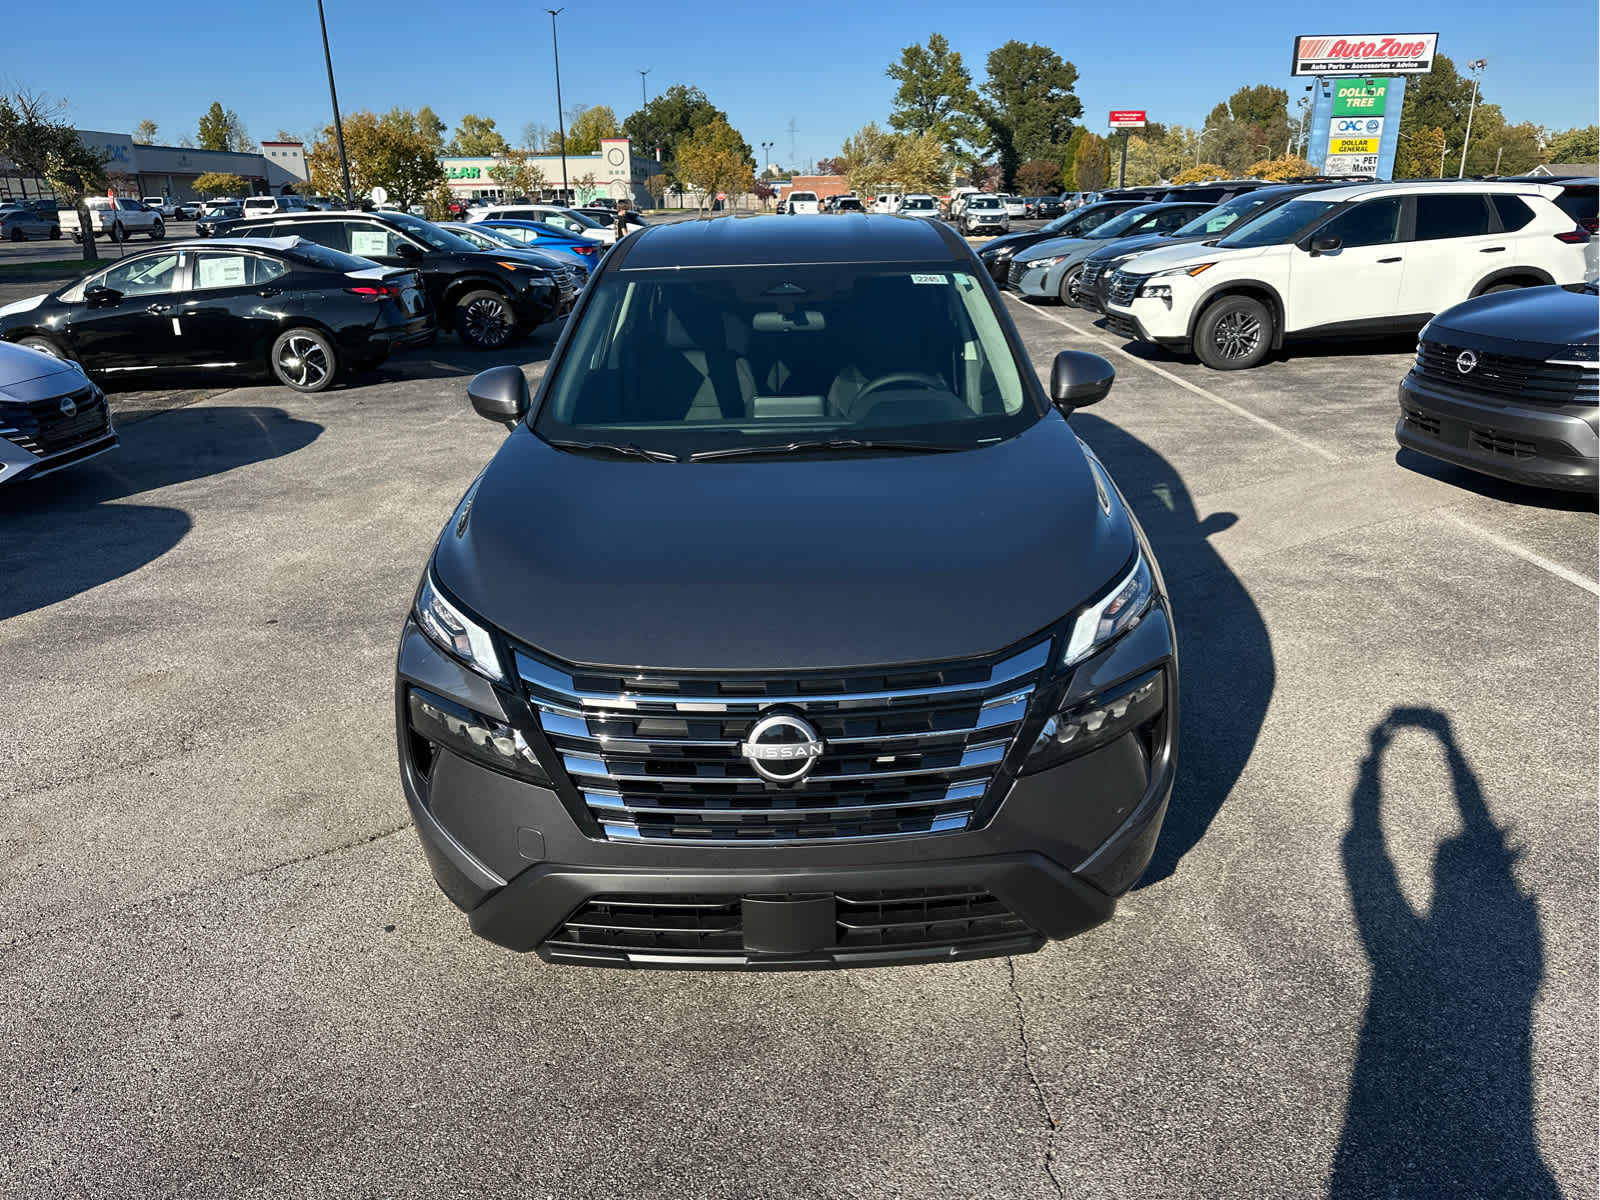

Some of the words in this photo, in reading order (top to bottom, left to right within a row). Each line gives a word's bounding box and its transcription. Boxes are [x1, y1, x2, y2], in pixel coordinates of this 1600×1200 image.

[1327, 38, 1425, 58] AutoZone
[1328, 62, 1346, 70] Parts
[1338, 87, 1386, 97] DOLLAR
[1346, 97, 1375, 107] TREE
[1363, 156, 1377, 165] PET
[742, 742, 823, 758] NISSAN
